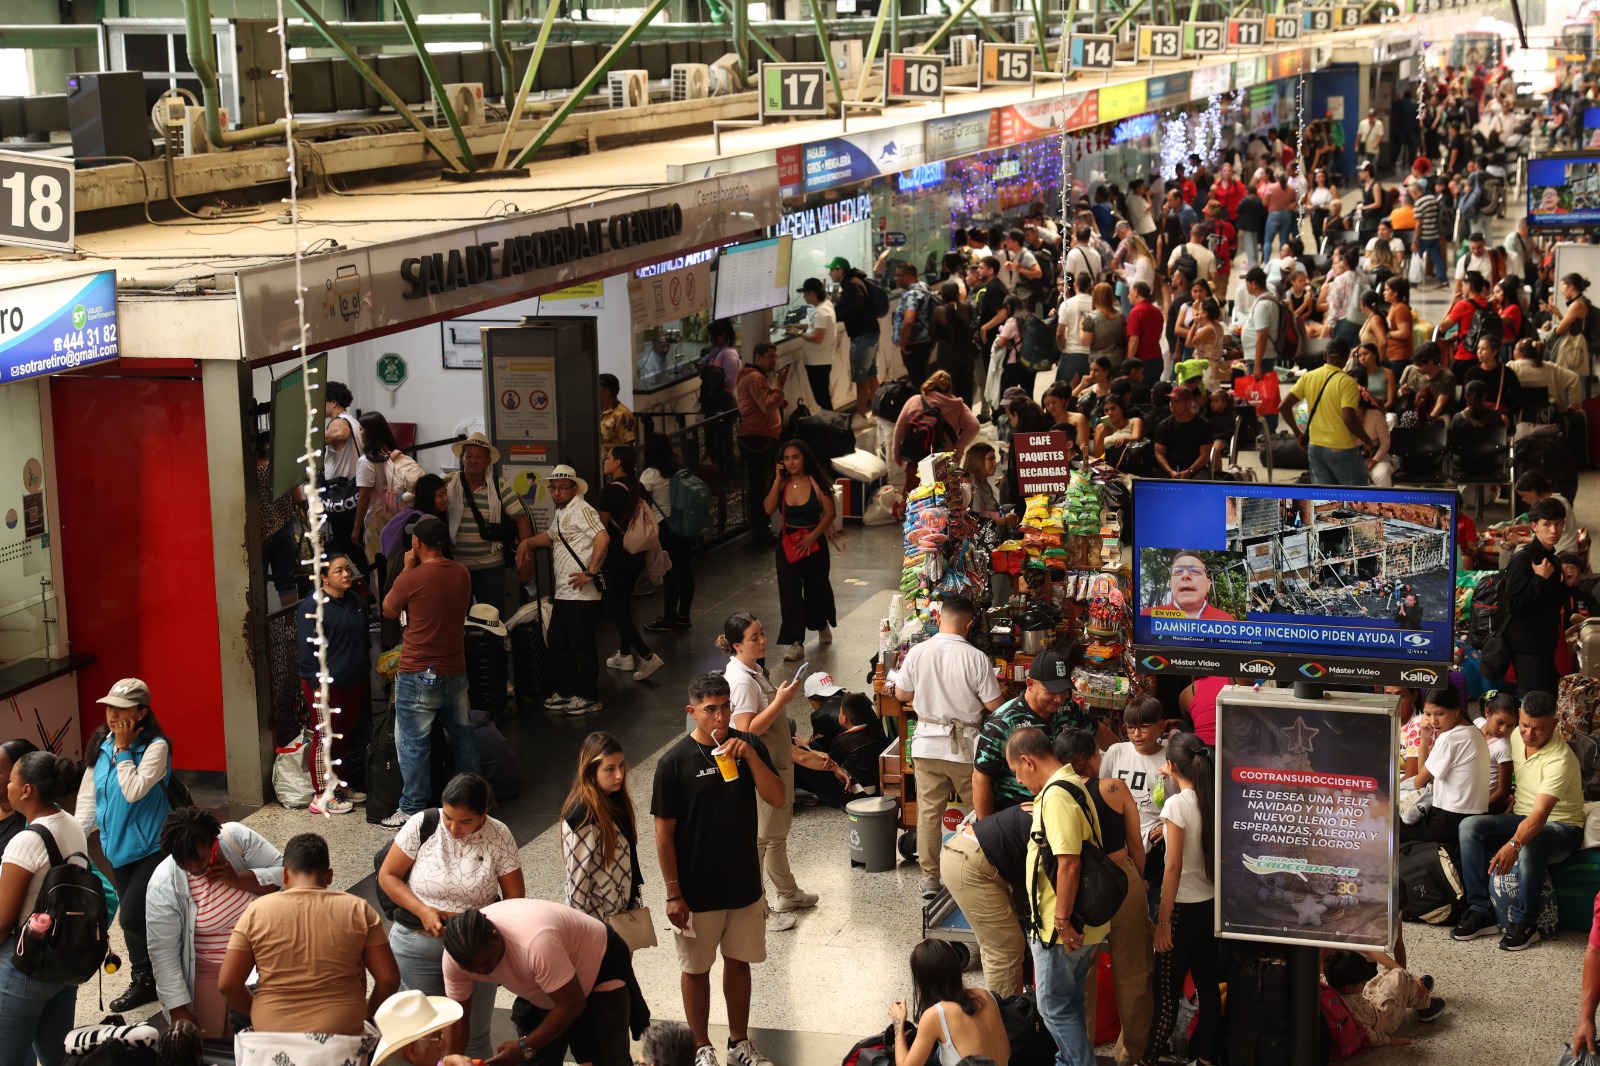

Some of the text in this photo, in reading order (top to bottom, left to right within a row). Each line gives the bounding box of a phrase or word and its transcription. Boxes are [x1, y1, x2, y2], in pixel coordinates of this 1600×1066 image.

[1314, 13, 1328, 29] 9
[1345, 9, 1359, 25] 8
[1239, 24, 1260, 44] 11
[1276, 19, 1296, 38] 10
[1152, 33, 1178, 55] 13
[1195, 28, 1220, 49] 12
[1085, 42, 1111, 66] 14
[998, 52, 1028, 78] 15
[906, 63, 938, 93] 16
[783, 73, 820, 106] 17
[2, 171, 64, 233] 18
[401, 249, 469, 299] SALA
[502, 217, 612, 278] ABORDAJE
[608, 203, 683, 250] CENTRO
[63, 323, 117, 350] 444 31 82
[19, 343, 118, 376] sotraretiro@gmail.com
[1029, 434, 1052, 446] CAFÉ
[1019, 450, 1065, 463] PAQUETES
[1019, 466, 1068, 478] RECARGAS
[1024, 482, 1066, 493] MINUTOS
[1155, 620, 1396, 644] DAMNIFICADOS POR INCENDIO PIDEN AYUDA
[1170, 658, 1221, 667] Máster Video
[1239, 662, 1277, 677] Kalley
[1328, 666, 1381, 676] Máster Video
[1400, 671, 1439, 685] Kalley
[1239, 770, 1373, 789] COOTRANSUROCCIDENTE
[1242, 789, 1370, 807] LES DESEA UNA FELIZ
[1247, 800, 1364, 817] NAVIDAD Y UN AÑO
[1253, 811, 1358, 828] NUEVO LLENO DE
[1232, 821, 1379, 841] ESPERANZAS, ALEGRIA Y
[1252, 833, 1361, 850] GRANDES LOGROS
[1257, 861, 1359, 877] UROCCIDENTE
[1259, 856, 1308, 865] COOTRANS
[1336, 881, 1358, 896] 30
